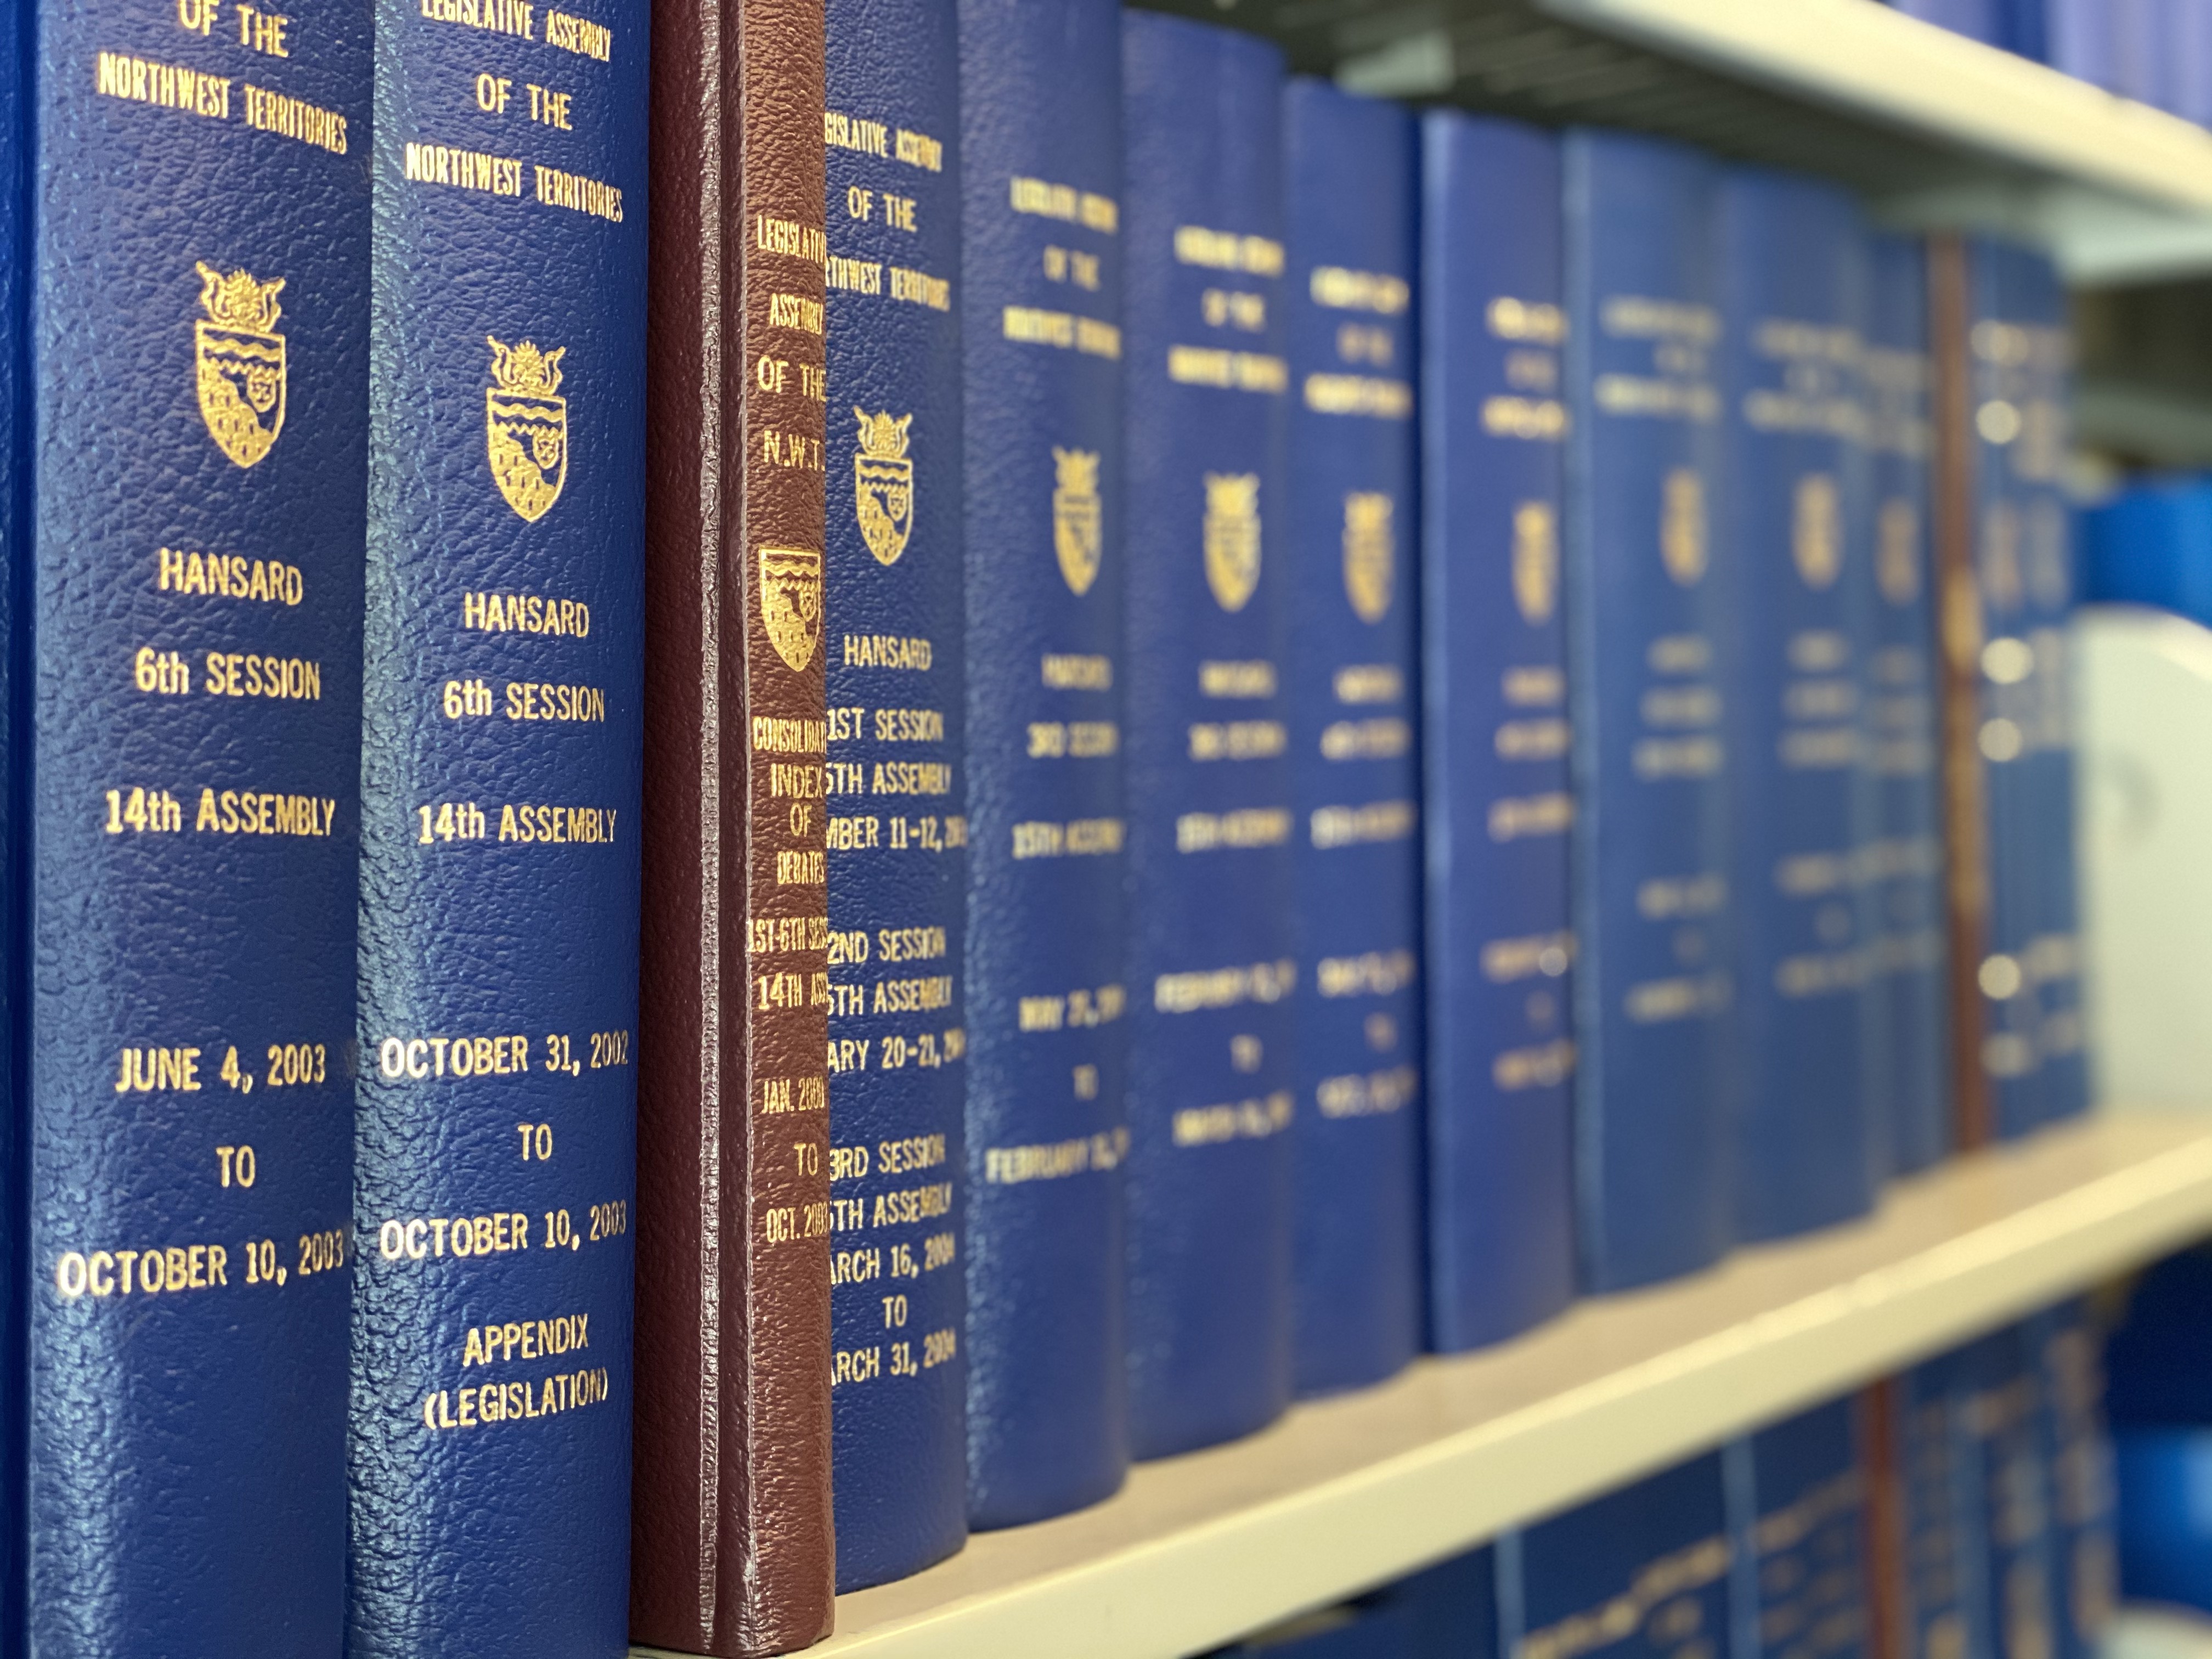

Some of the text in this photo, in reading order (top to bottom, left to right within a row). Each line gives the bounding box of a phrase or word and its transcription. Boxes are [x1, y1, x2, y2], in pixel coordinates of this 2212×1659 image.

[179, 0, 289, 57] OF THE
[546, 9, 611, 62] ASSEMBLY
[97, 52, 348, 155] NORTHWEST TERRITORIES
[476, 74, 572, 131] OF THE
[406, 142, 623, 223] NORTHWEST TERRITORIES
[848, 185, 917, 233] OF THE
[758, 356, 826, 402] OF THE
[160, 548, 302, 605] HANSARD
[465, 592, 589, 637] HANSARD
[134, 646, 320, 699] 6th SESSION
[844, 635, 932, 671] HANSARD
[443, 679, 604, 722] 6th SESSION
[753, 716, 826, 753] CONSOLIDAT
[827, 707, 944, 742] 1ST SESSION
[771, 763, 822, 798] INDEX
[105, 787, 335, 836] 14th ASSEMBLY
[417, 802, 617, 844] 14th ASSEMBLY
[790, 803, 812, 837] OF
[777, 851, 824, 884] DEBATES
[827, 926, 946, 964] 2ND SESSION
[758, 972, 802, 1009] 14TH
[115, 1044, 325, 1094] JUNE 4, 2003
[380, 1029, 629, 1079] OCTOBER 31, 2002
[761, 1079, 794, 1114] JAN.
[517, 1123, 552, 1160] TO
[794, 1143, 818, 1176] TO
[830, 1133, 945, 1181] 3RD SESSION
[217, 1145, 256, 1187] TO
[766, 1201, 827, 1244] OCT. 2003
[830, 1182, 952, 1232] TH ASSEMBLY
[380, 1200, 627, 1260] OCTOBER 10, 2003
[57, 1228, 344, 1296] OCTOBER 10, 2003
[891, 1243, 918, 1278] 16,
[882, 1295, 907, 1329] TO
[462, 1313, 588, 1368] APPENDIX
[890, 1341, 917, 1376] 31,
[424, 1367, 607, 1430] (LEGISLATION)
